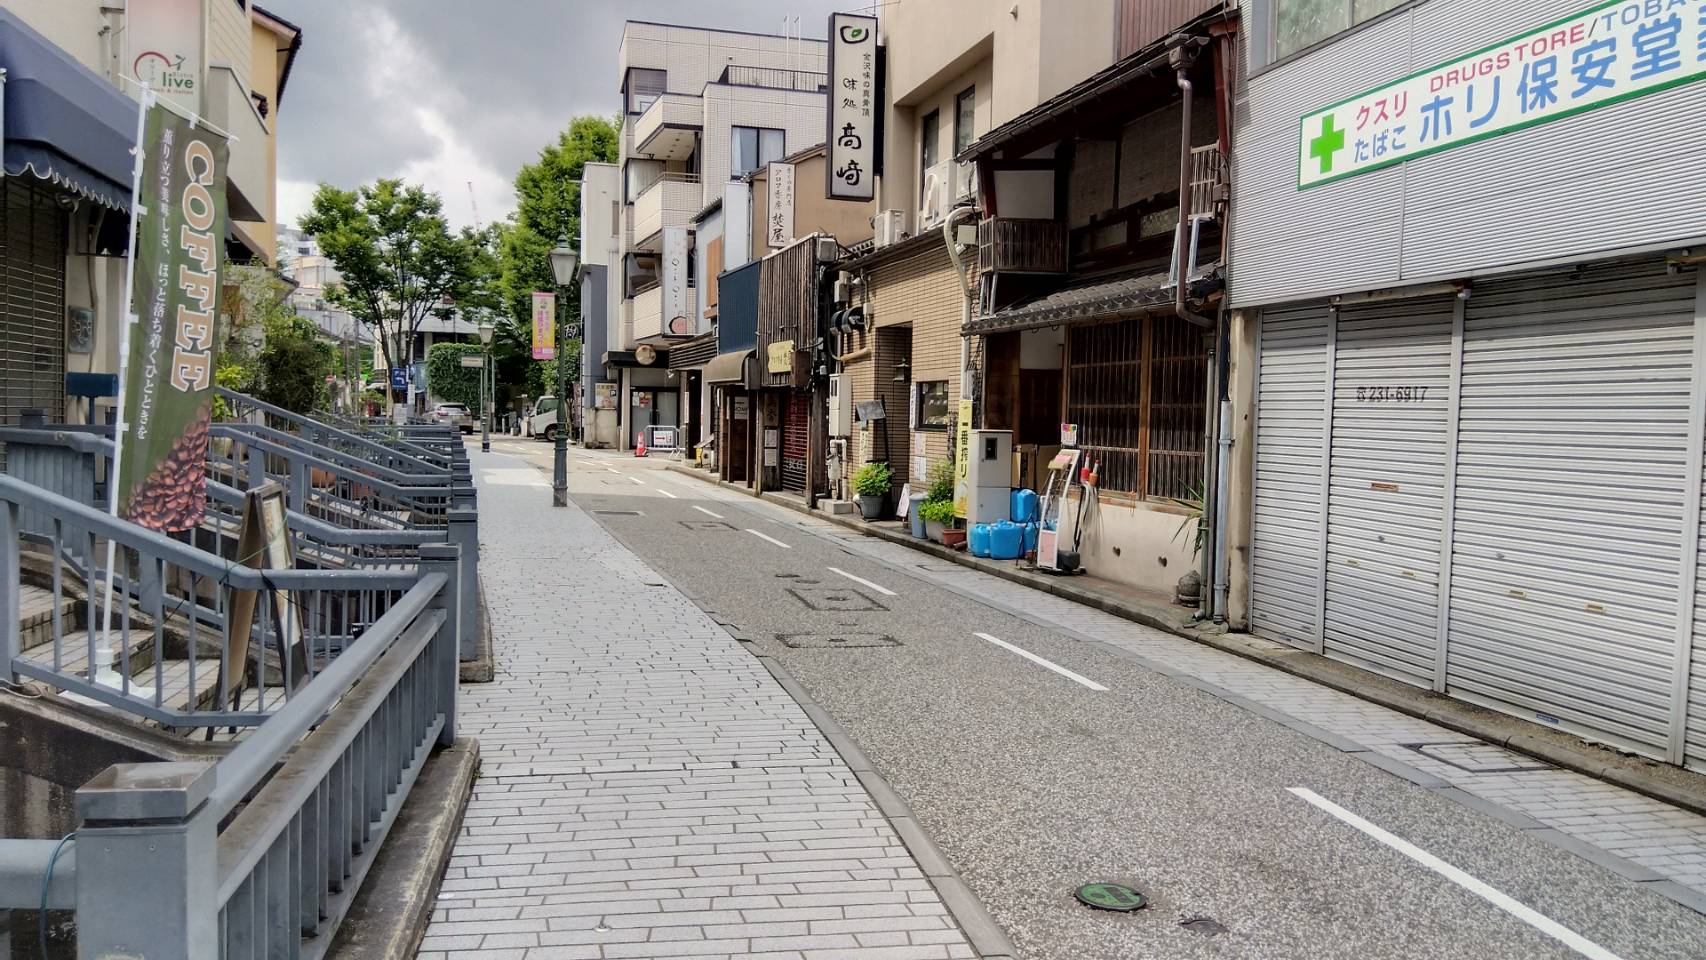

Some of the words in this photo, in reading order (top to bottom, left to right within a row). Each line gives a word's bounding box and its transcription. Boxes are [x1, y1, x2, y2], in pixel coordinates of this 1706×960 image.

[862, 53, 871, 117] 金沢味の真骨頂
[1355, 90, 1408, 132] クスリ
[1353, 124, 1407, 164] たばこ
[170, 139, 216, 393] COFFEE
